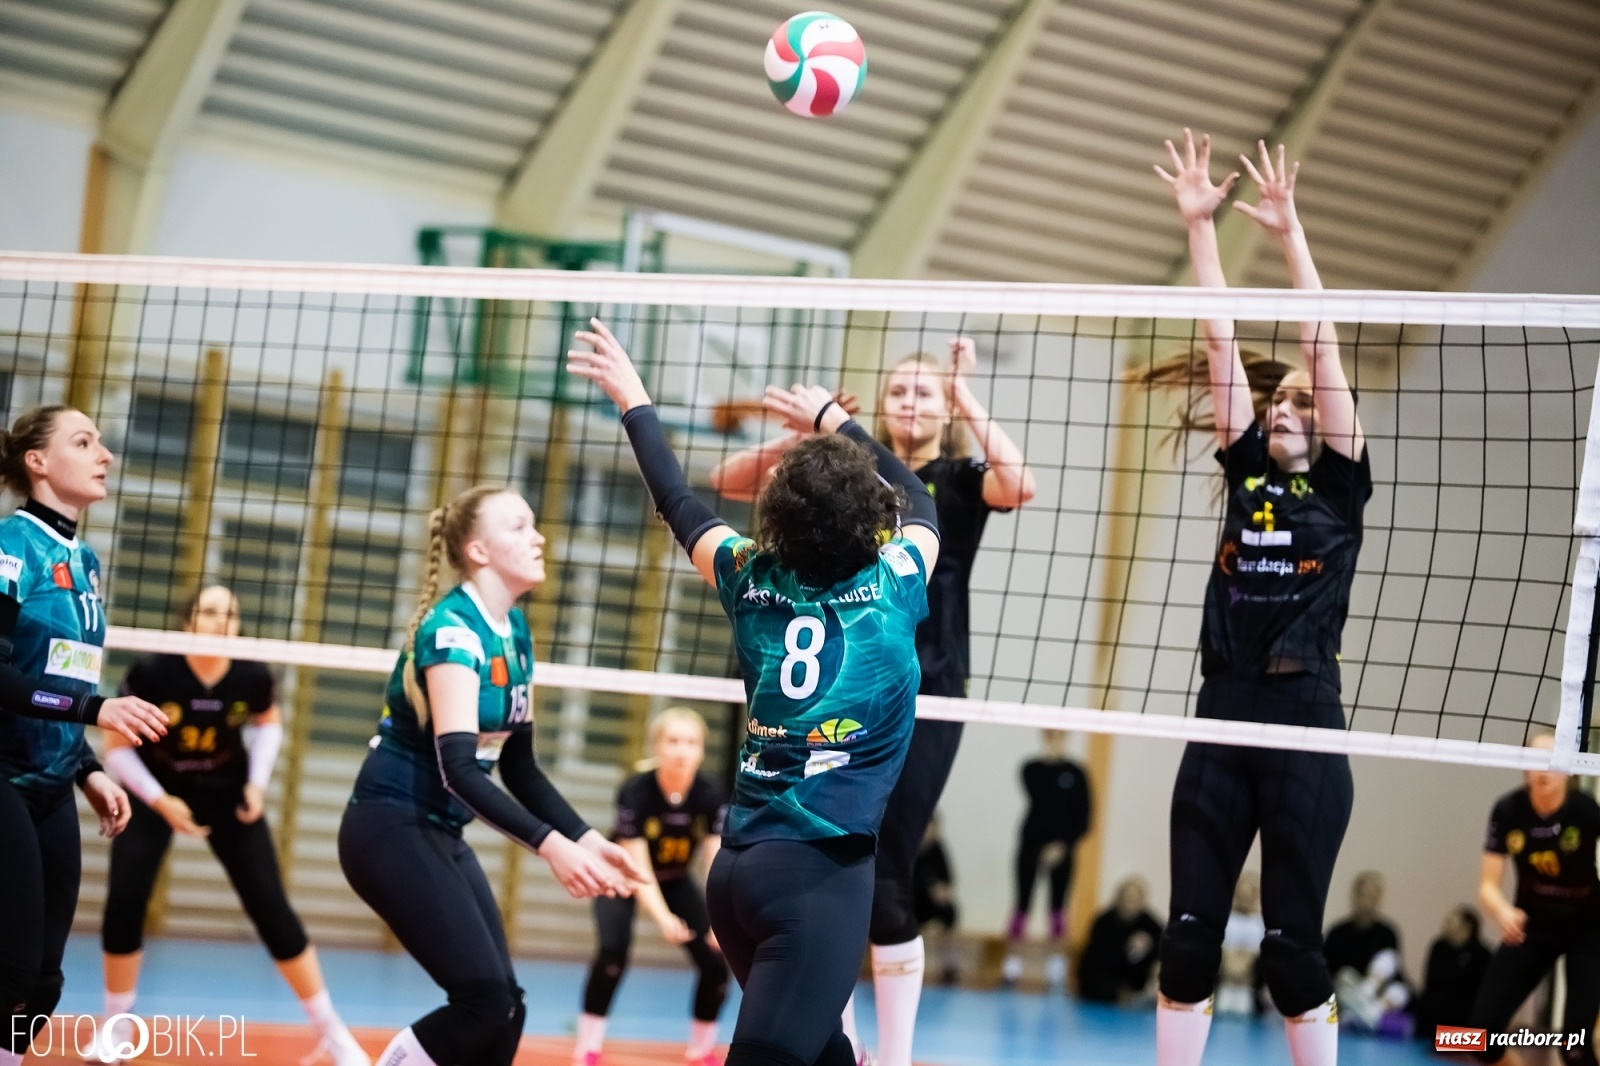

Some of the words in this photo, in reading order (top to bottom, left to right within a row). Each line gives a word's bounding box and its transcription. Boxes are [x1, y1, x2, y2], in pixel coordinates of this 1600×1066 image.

[79, 591, 98, 632] 17
[779, 616, 826, 700] 8
[507, 684, 529, 724] 15
